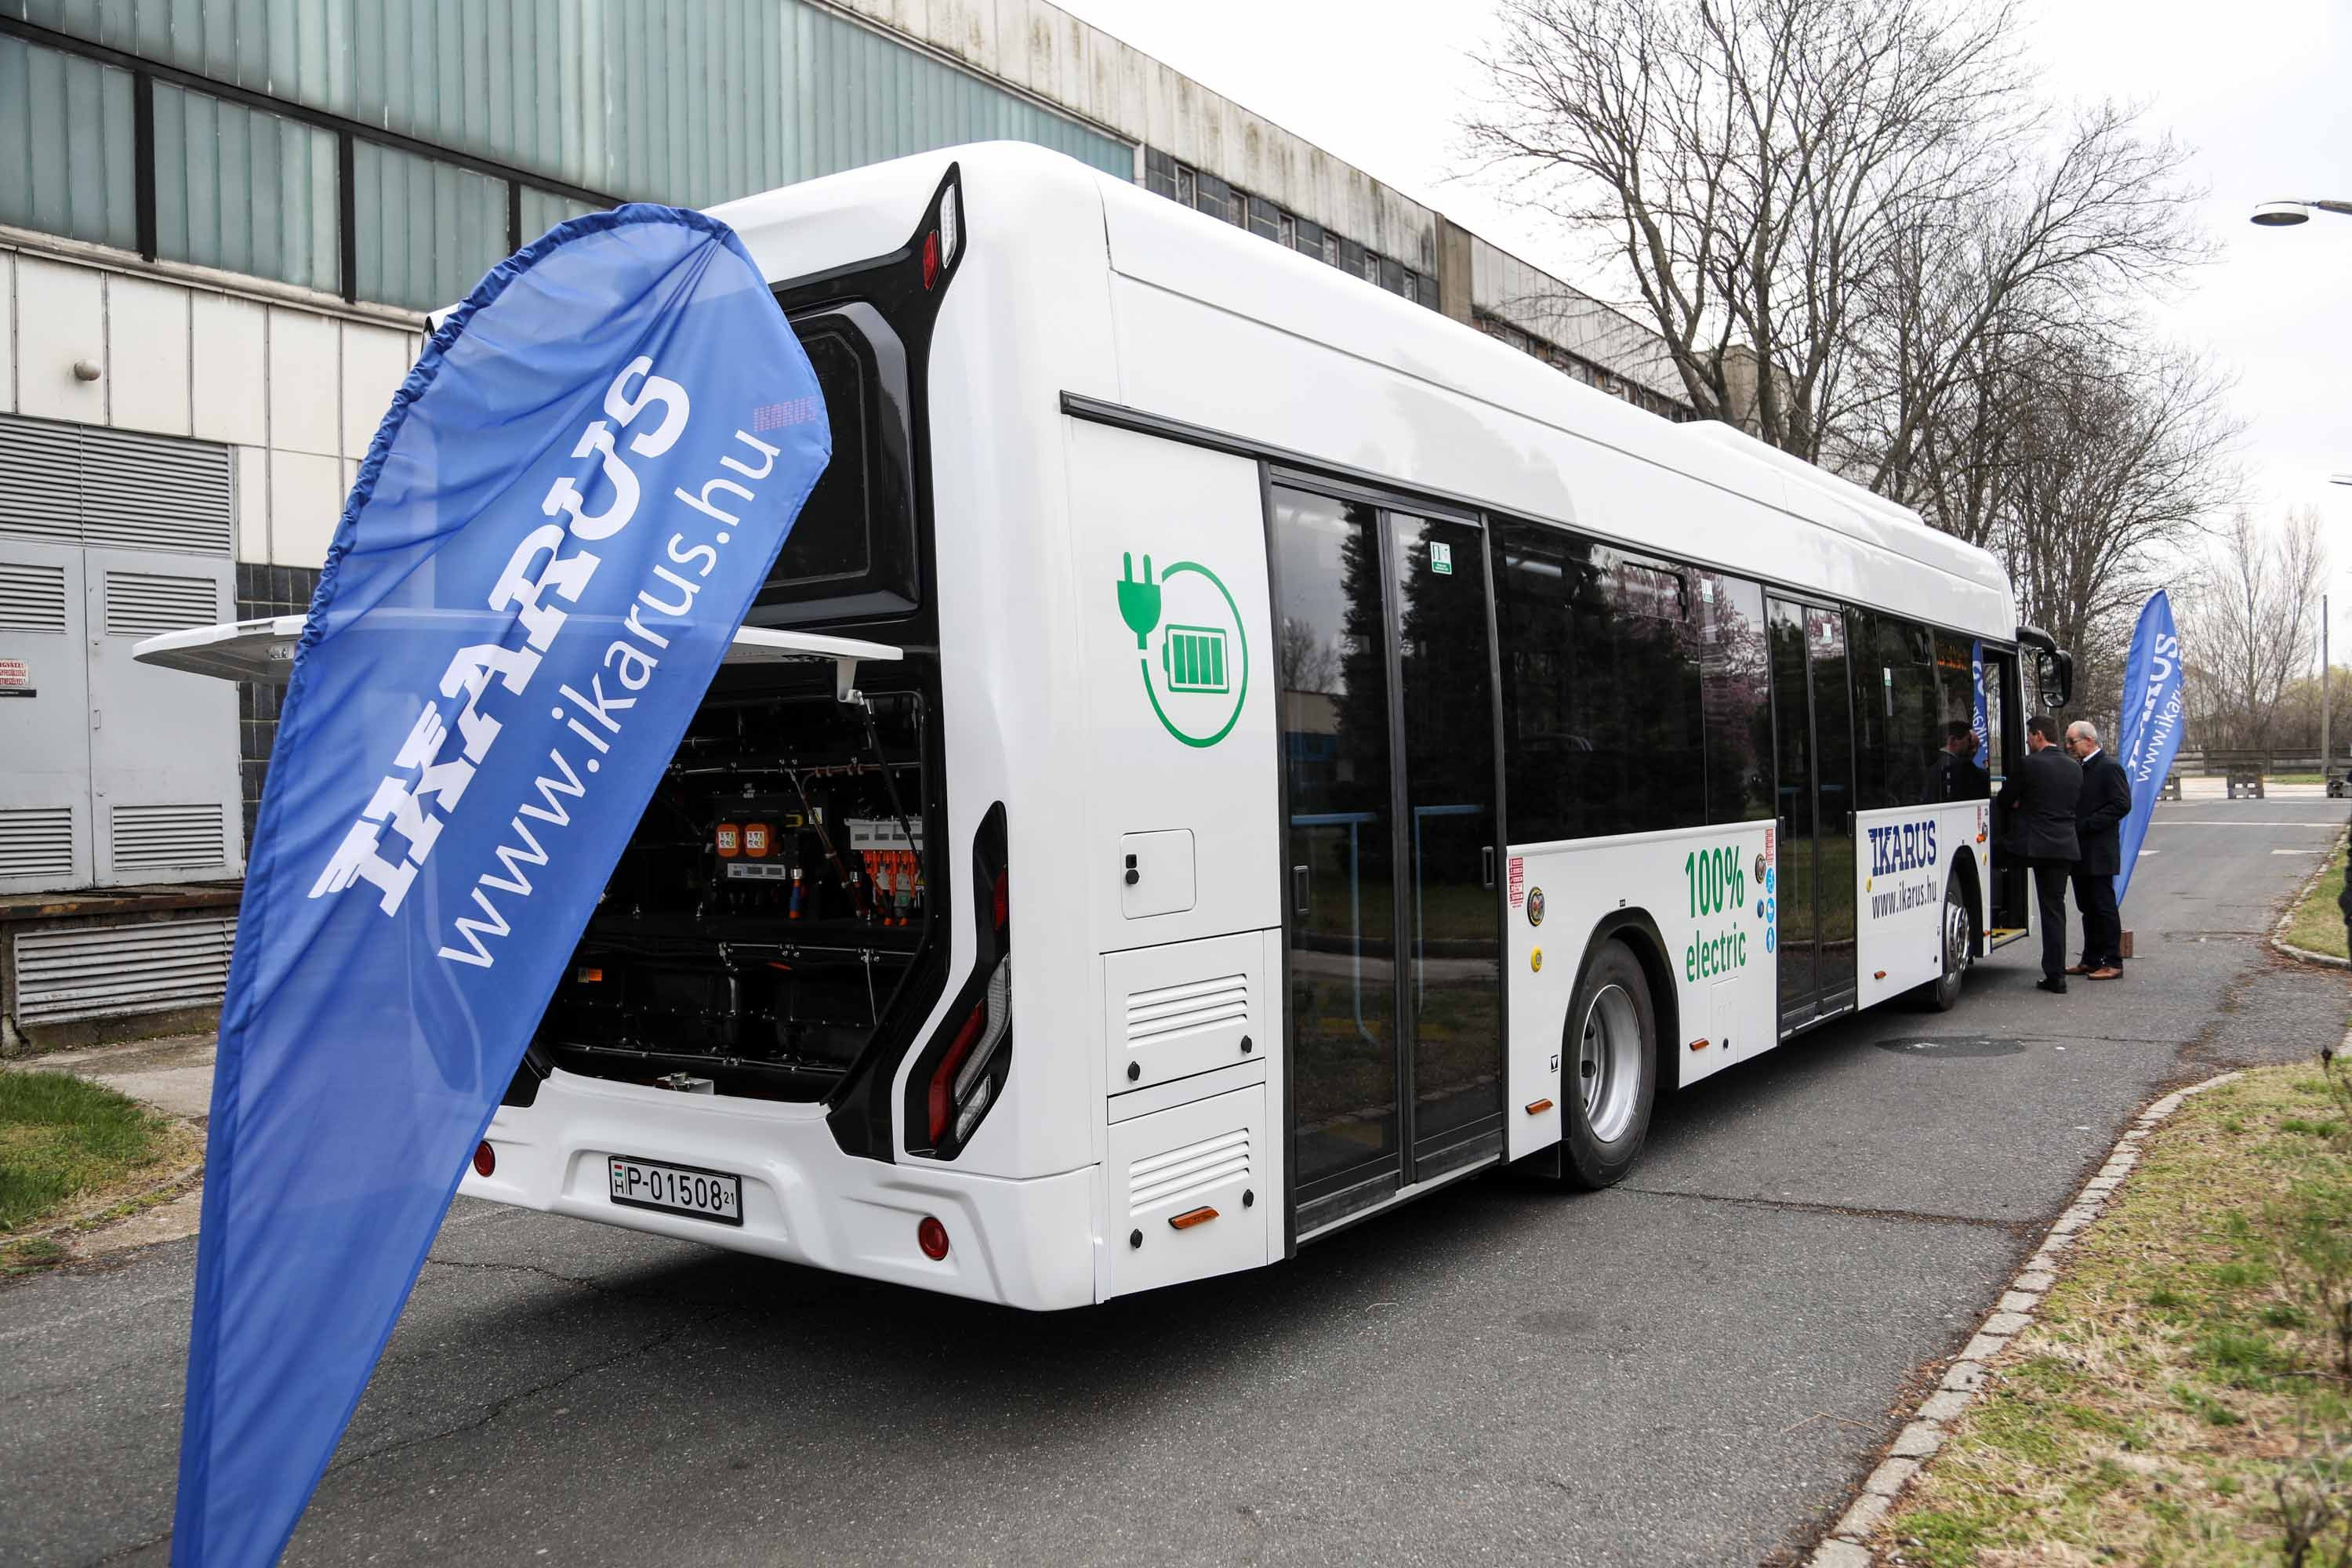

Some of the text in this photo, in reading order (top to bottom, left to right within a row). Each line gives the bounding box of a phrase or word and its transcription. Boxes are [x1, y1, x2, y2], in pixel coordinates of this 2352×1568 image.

[307, 356, 689, 917] IKARUS
[437, 430, 781, 968] www.ikarus.hu
[1867, 820, 1936, 877] IKARUS
[1685, 846, 1744, 918] 100%
[1872, 876, 1936, 919] www.ikarus.hu
[1686, 922, 1746, 982] electric
[615, 1167, 735, 1210] H P-01508 21
